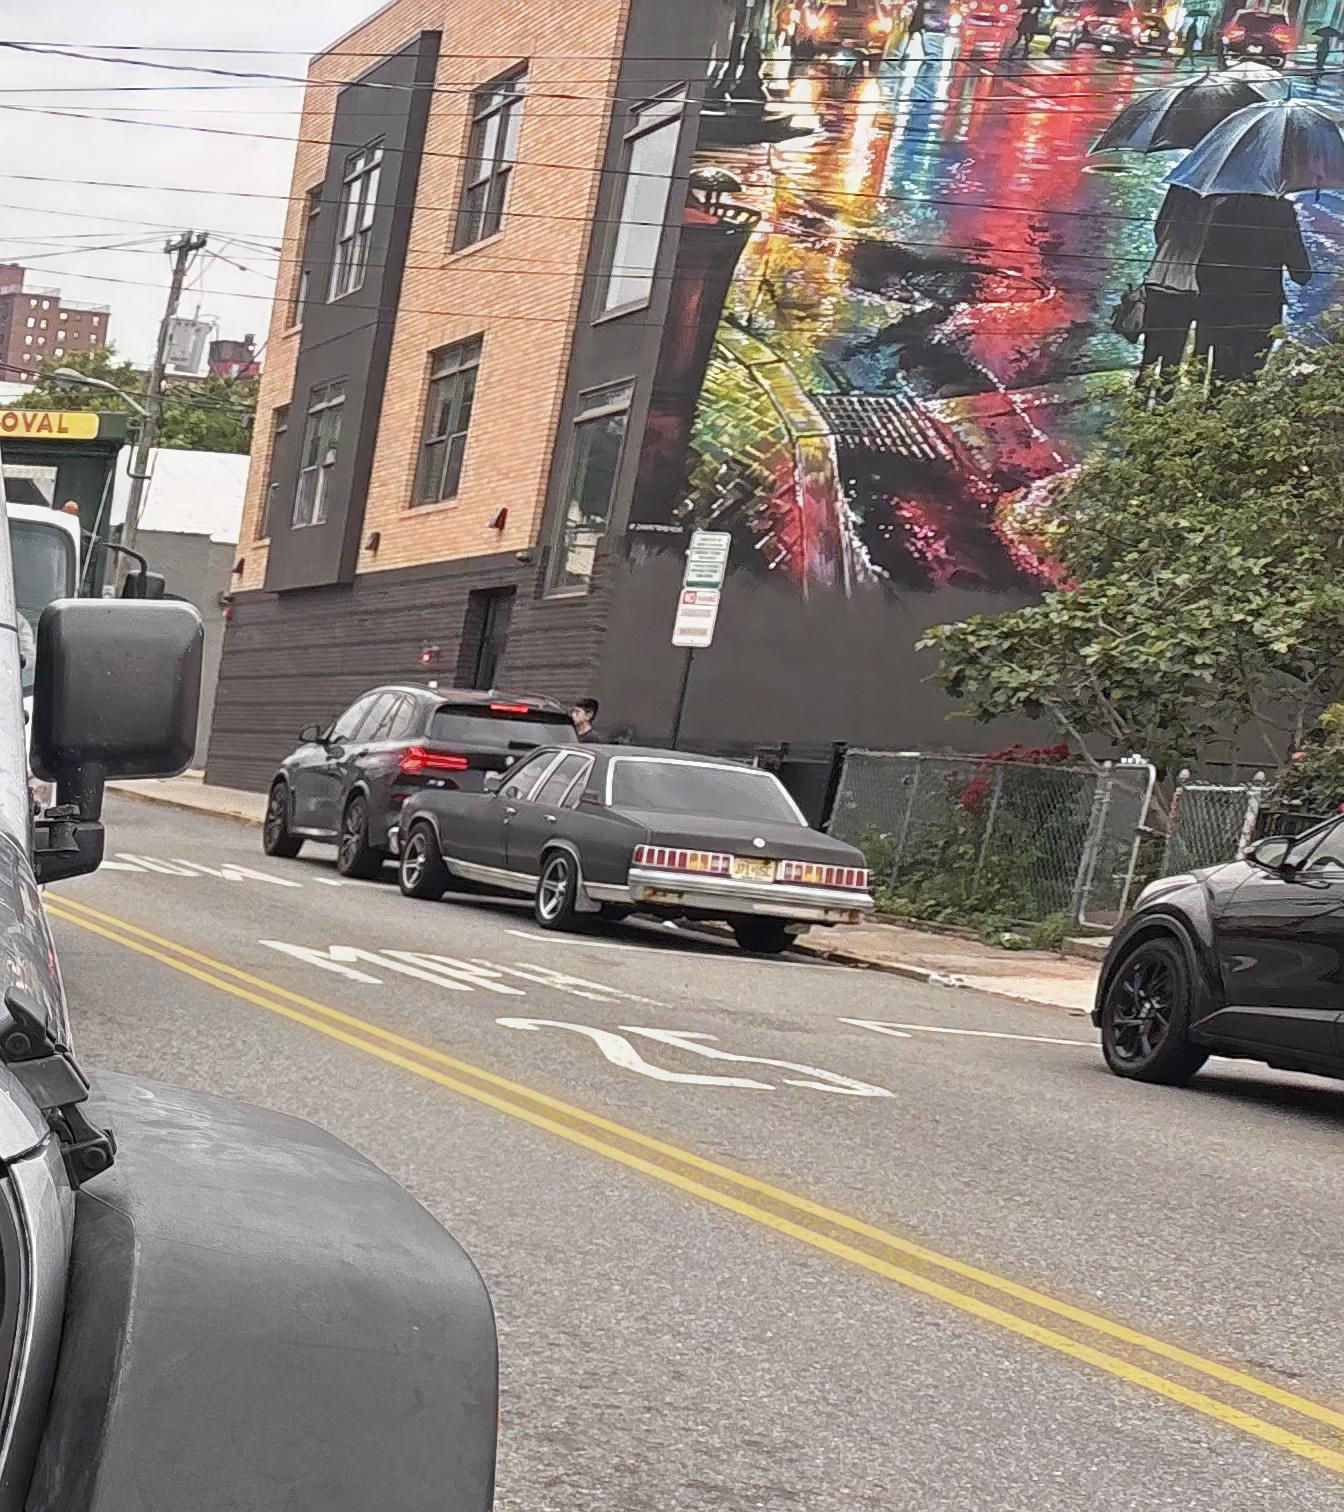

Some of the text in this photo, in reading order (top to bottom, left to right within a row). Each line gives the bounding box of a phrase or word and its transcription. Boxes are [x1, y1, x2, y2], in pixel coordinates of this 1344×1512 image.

[2, 412, 69, 434] OVAL
[258, 939, 673, 1008] MPH
[493, 1016, 895, 1098] 25
